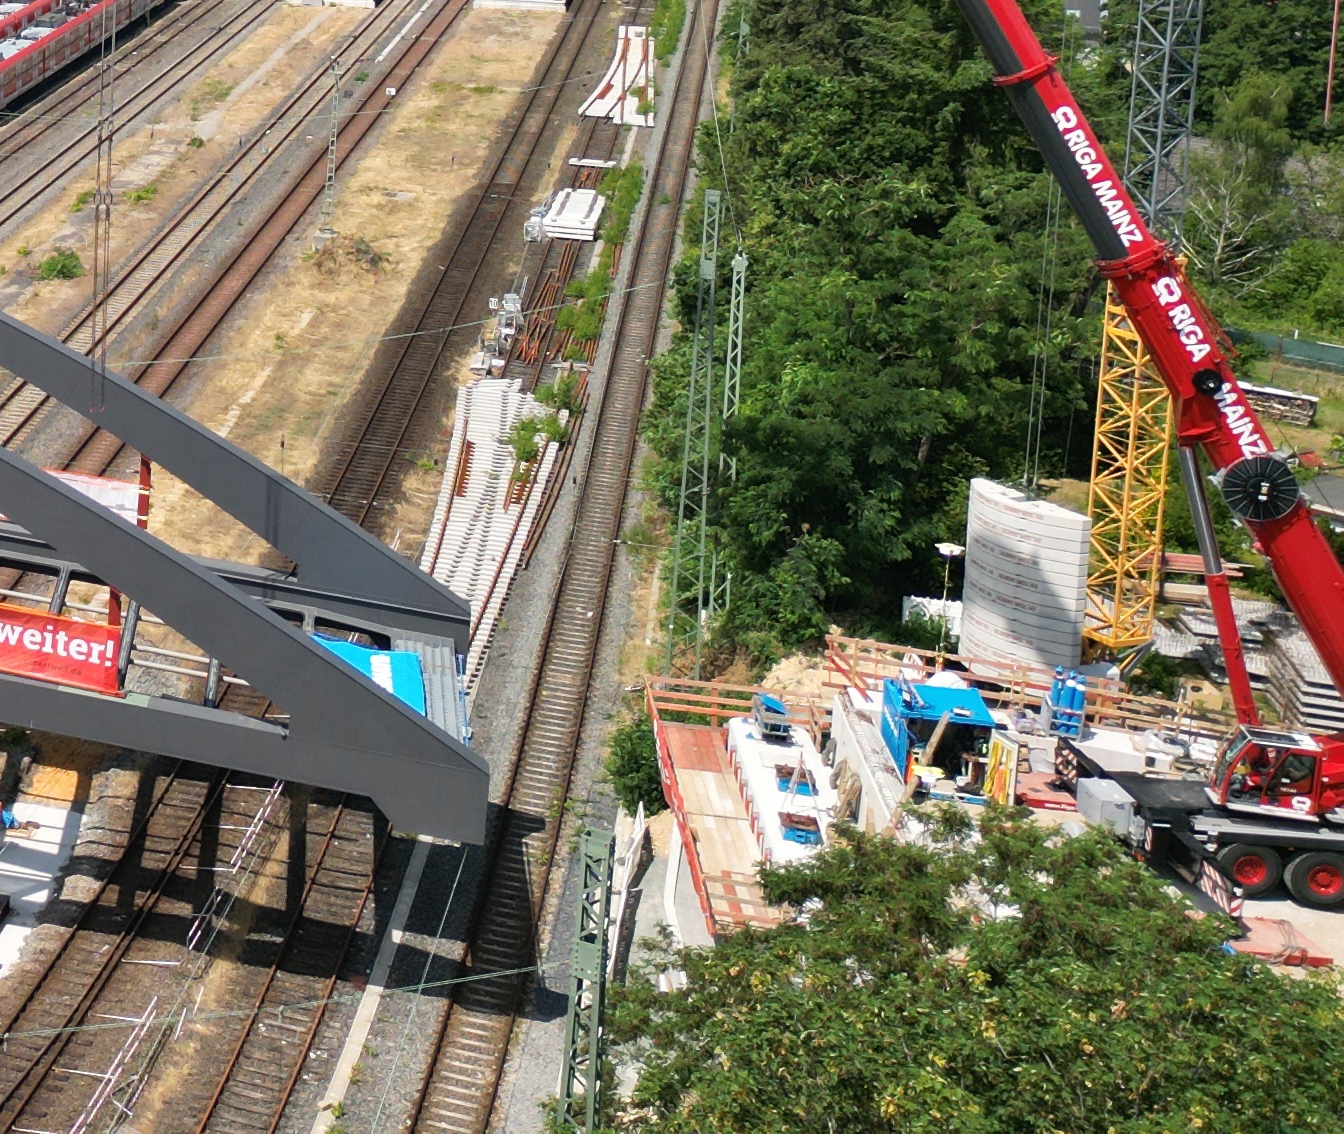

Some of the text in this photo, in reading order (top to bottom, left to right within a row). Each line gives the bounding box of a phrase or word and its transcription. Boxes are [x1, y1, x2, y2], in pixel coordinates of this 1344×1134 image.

[1064, 128, 1143, 248] RIGA MAINZ
[1168, 303, 1268, 460] RIGA MAINZ
